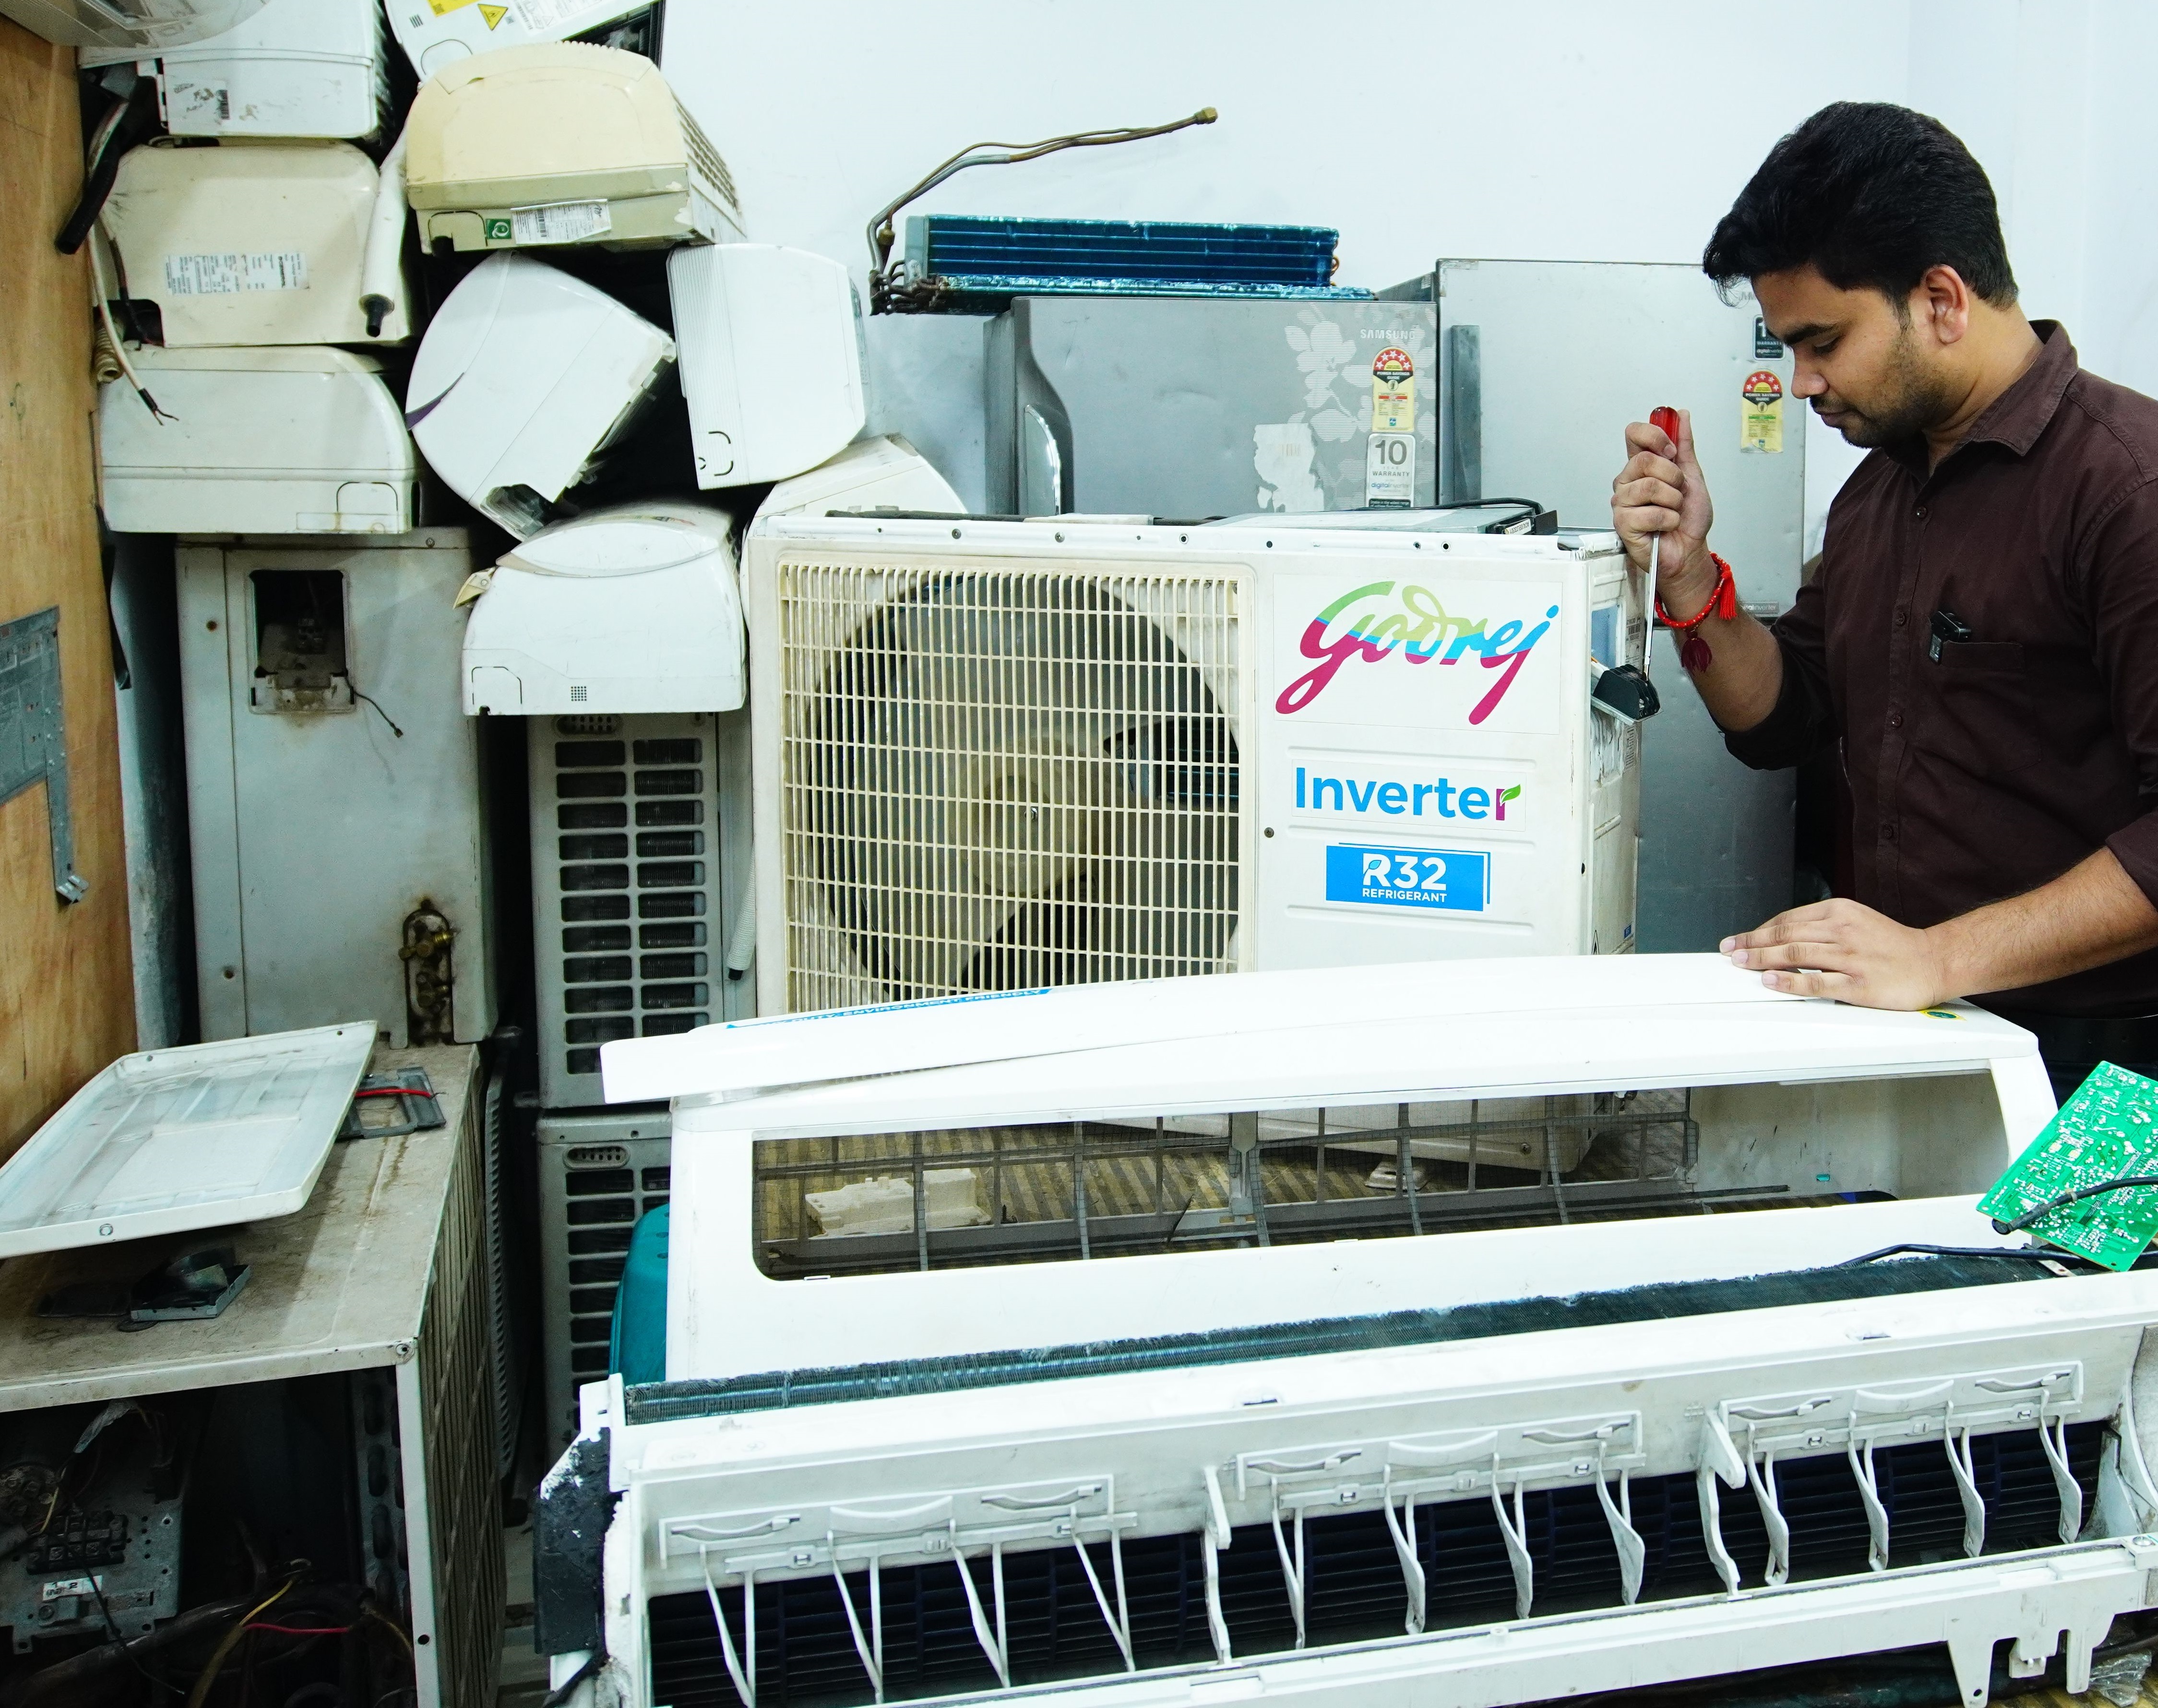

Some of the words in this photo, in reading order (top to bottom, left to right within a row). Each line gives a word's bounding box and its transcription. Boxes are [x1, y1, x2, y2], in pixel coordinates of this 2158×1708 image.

[1360, 329, 1416, 339] SAMSUNG
[1375, 440, 1407, 465] 10
[1296, 767, 1521, 820] Inverter
[1362, 853, 1447, 891] R32
[1362, 888, 1447, 903] REFRIGERANT
[843, 998, 959, 1015] ENVIRONMENT
[965, 990, 1041, 1001] FRIENDLY
